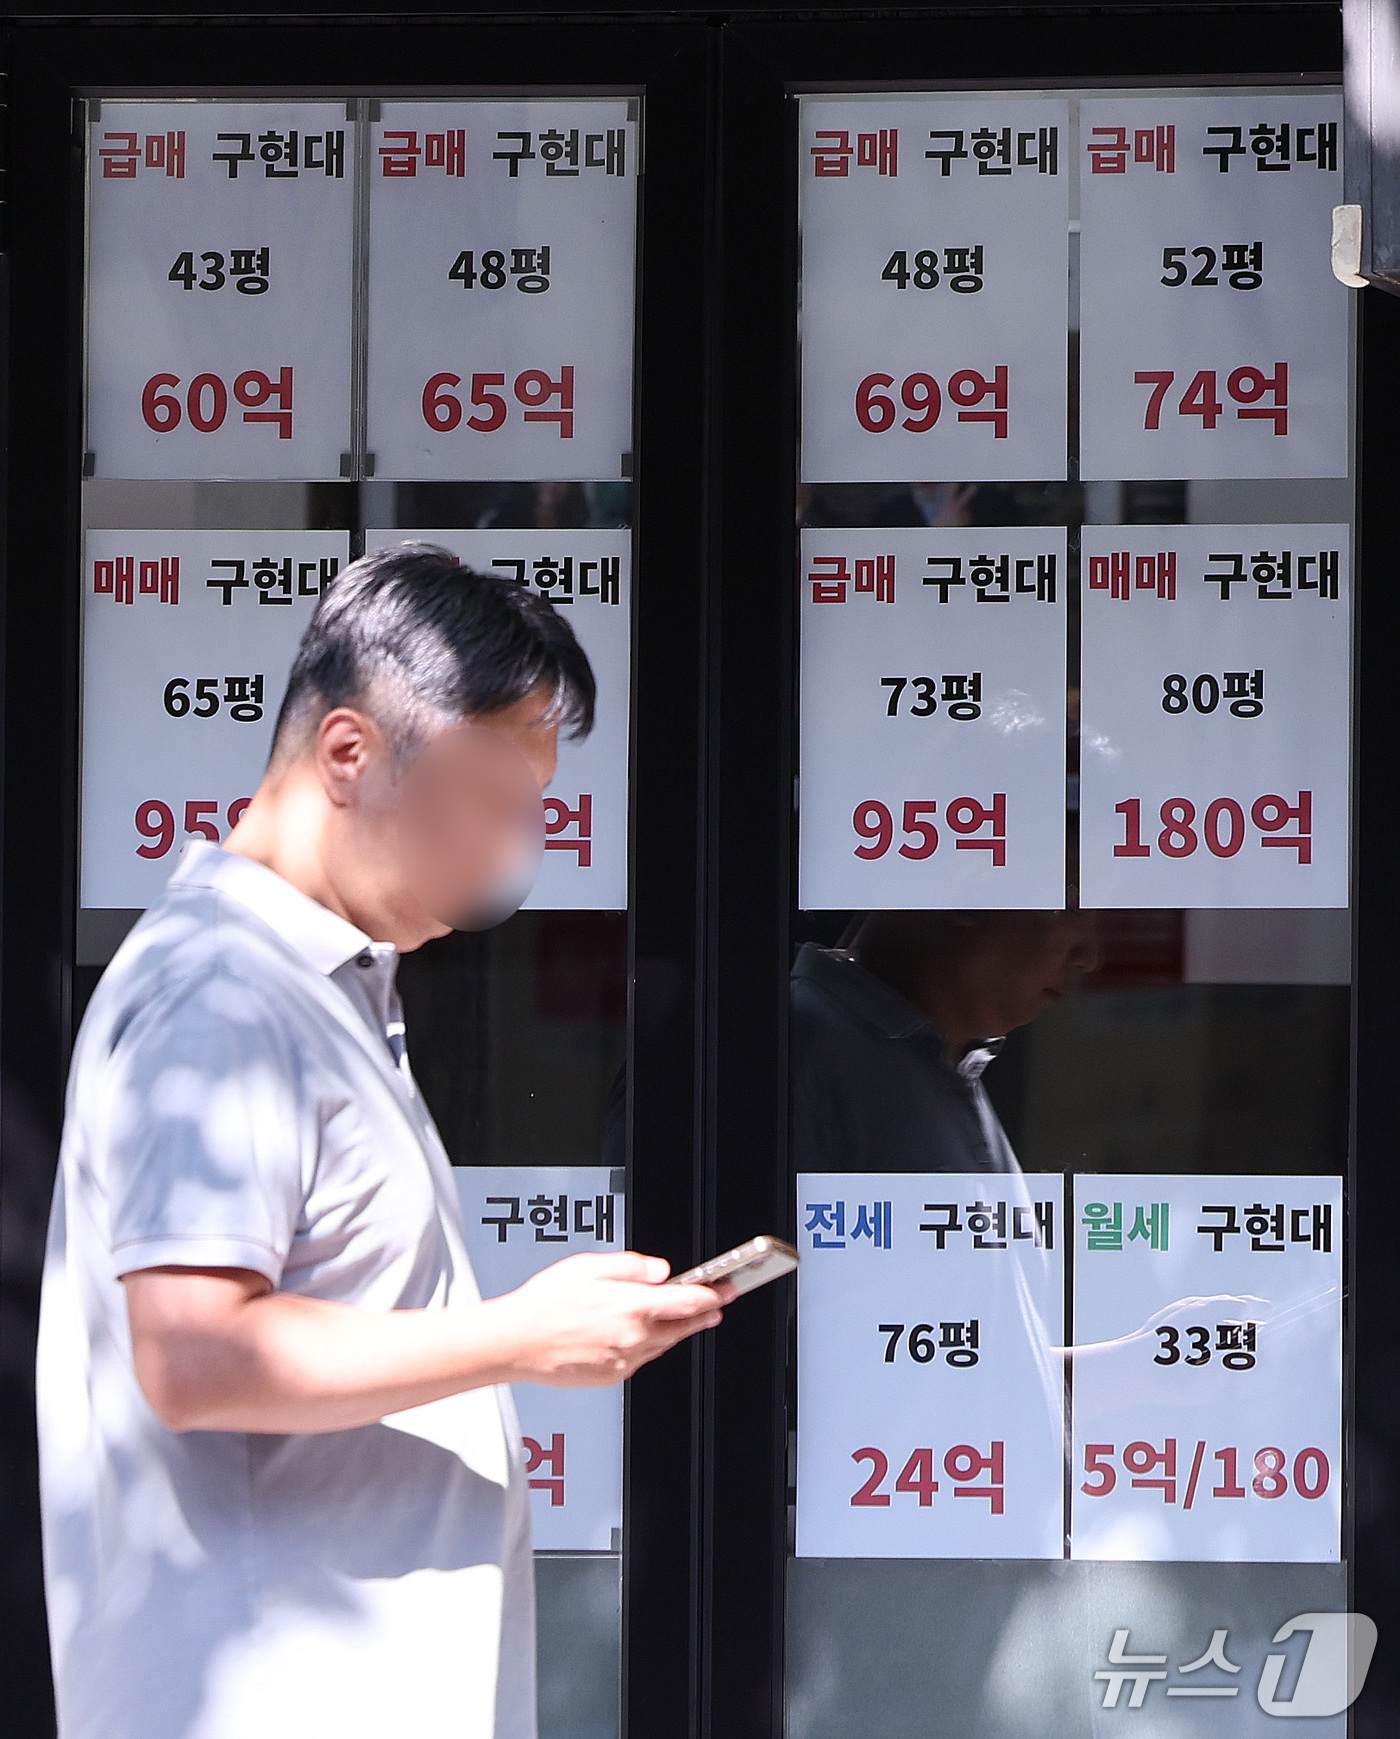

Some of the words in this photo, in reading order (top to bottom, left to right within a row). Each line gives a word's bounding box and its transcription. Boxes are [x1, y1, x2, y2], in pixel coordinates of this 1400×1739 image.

[99, 131, 185, 178] 급매
[213, 131, 344, 178] 구현대
[379, 130, 465, 177] 급매
[493, 129, 625, 177] 구현대
[811, 129, 897, 177] 급매
[925, 127, 1057, 176] 구현대
[1088, 125, 1175, 173] 급매
[1203, 123, 1337, 172] 구현대
[169, 248, 269, 294] 43평
[449, 246, 550, 293] 48평
[882, 246, 983, 293] 48평
[1162, 242, 1262, 290] 52평
[142, 367, 293, 439] 60억
[423, 366, 573, 438] 65억
[856, 366, 1007, 438] 69억
[1135, 363, 1287, 435] 74억
[94, 557, 179, 604] 매매
[207, 558, 338, 605] 구현대
[808, 556, 895, 603] 급매
[923, 555, 1056, 603] 구현대
[1090, 552, 1176, 600] 매매
[1204, 551, 1338, 600] 구현대
[164, 675, 263, 722] 65평
[881, 673, 981, 720] 73평
[1163, 670, 1263, 718] 80평
[135, 798, 253, 859] 95
[853, 794, 1006, 866] 95억
[1114, 791, 1311, 864] 180억
[481, 1194, 614, 1242] 구현대
[805, 1202, 891, 1249] 전세
[920, 1202, 1053, 1249] 구현대
[1082, 1203, 1169, 1250] 월세
[1198, 1204, 1331, 1252] 구현대
[879, 1320, 978, 1367] 76평
[1154, 1323, 1255, 1370] 33평
[851, 1442, 1003, 1514] 24억
[1082, 1439, 1329, 1509] 5억/180
